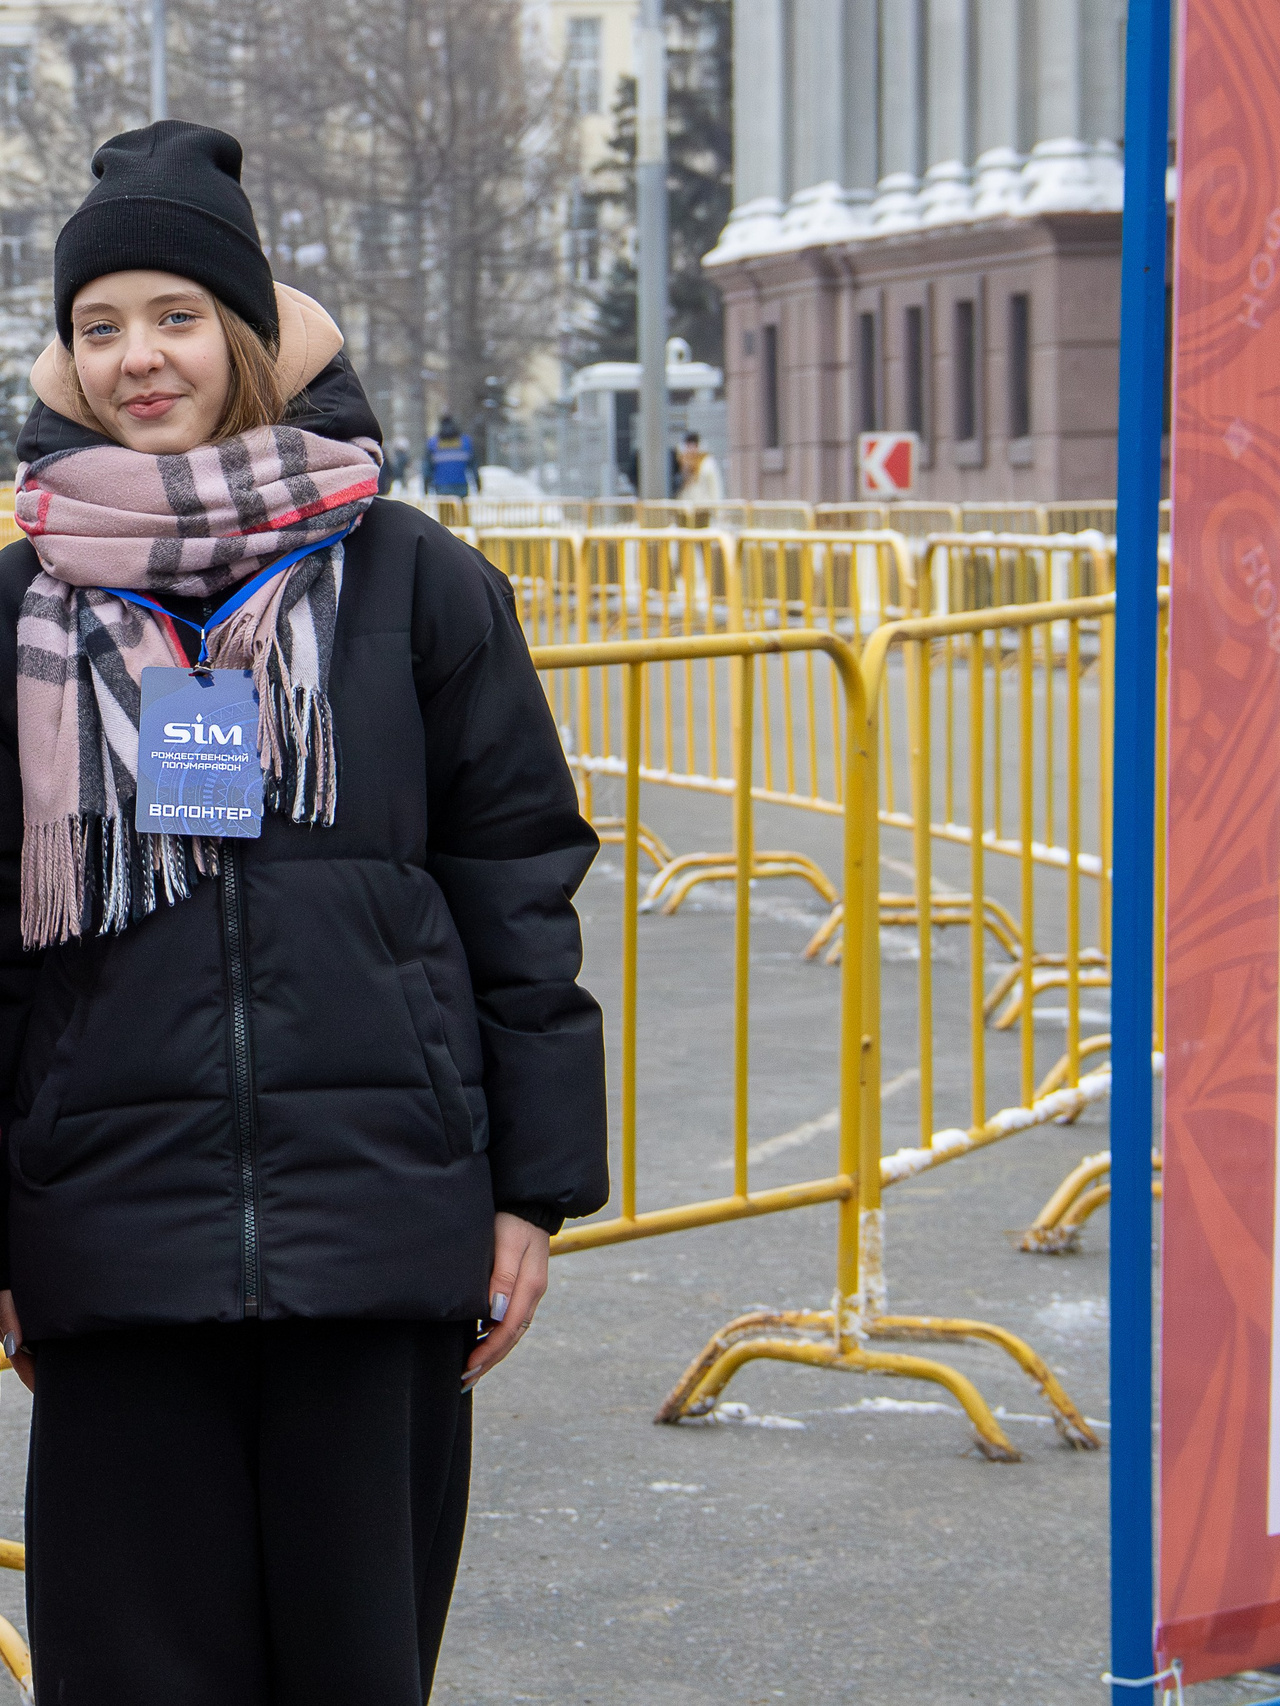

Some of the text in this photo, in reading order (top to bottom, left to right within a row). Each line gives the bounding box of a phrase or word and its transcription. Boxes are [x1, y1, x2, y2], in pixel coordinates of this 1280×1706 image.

[151, 752, 249, 762] РОЖДЕСТВЕНСКИЙ
[161, 761, 242, 772] ПОЛУМАРАФОН
[149, 804, 251, 820] ВОЛОНТЕР
